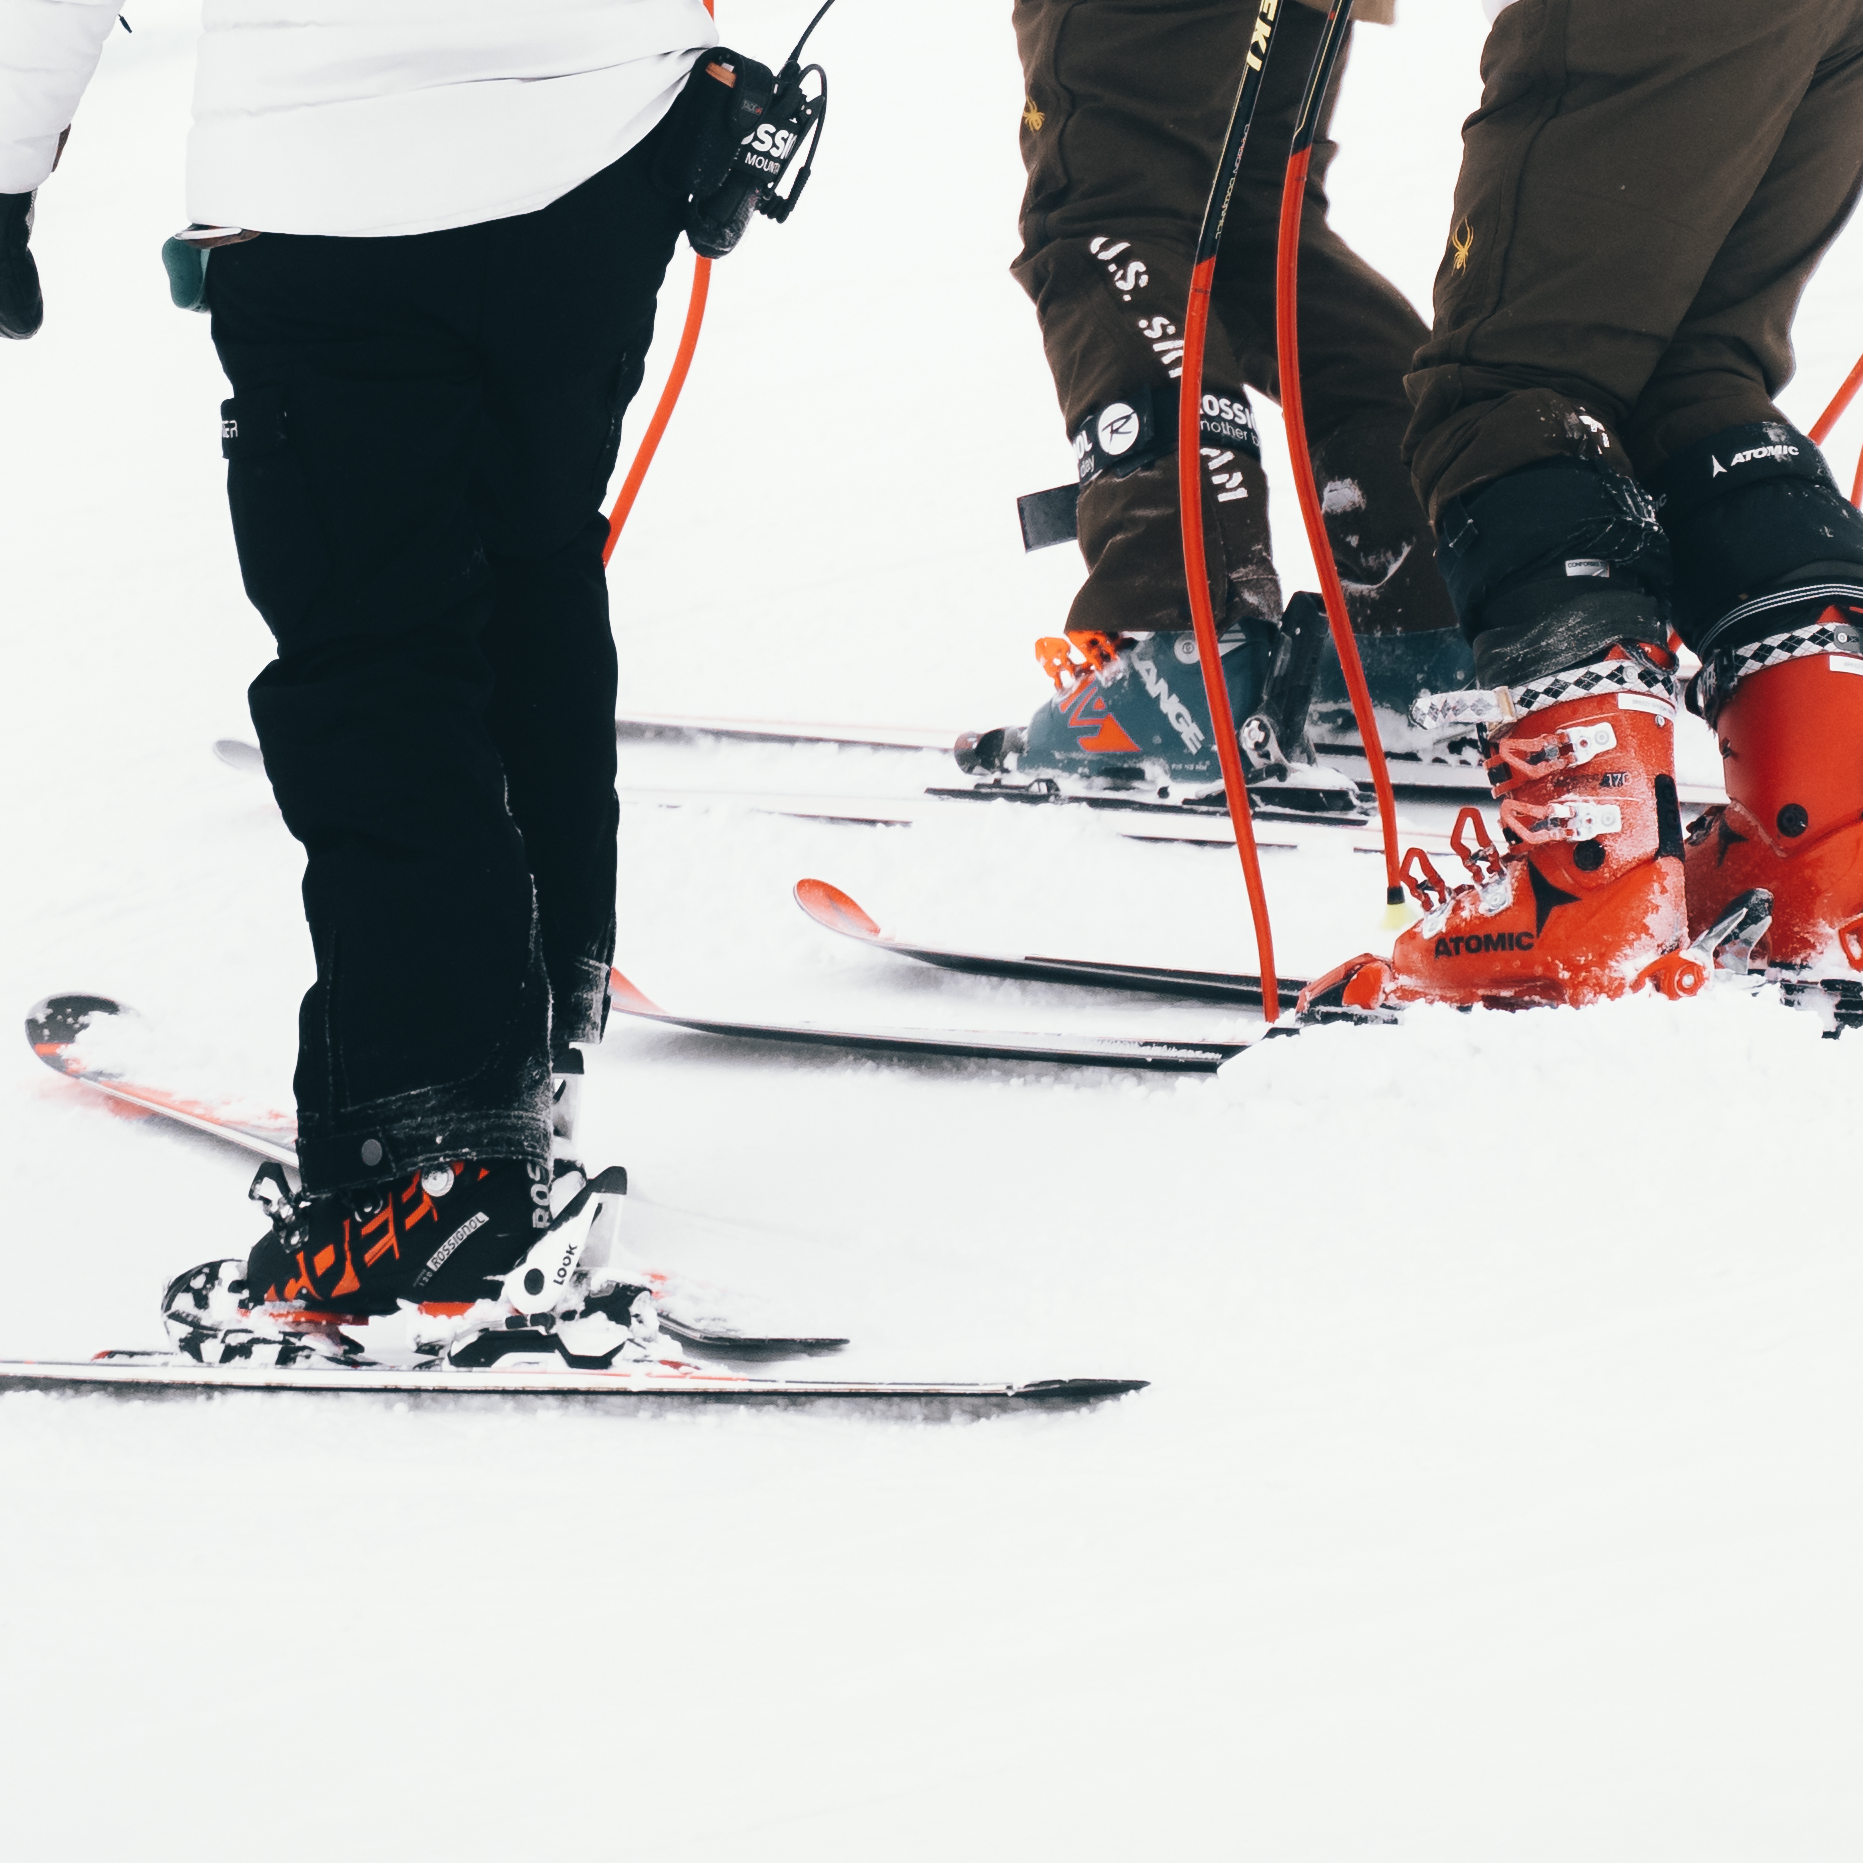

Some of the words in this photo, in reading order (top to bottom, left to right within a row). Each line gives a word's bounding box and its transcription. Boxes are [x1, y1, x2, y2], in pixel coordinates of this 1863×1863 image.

[1090, 236, 1149, 302] U.S.
[1200, 419, 1248, 441] nother
[1730, 444, 1800, 466] ATOMIC
[1434, 931, 1535, 959] ATOMIC
[431, 1215, 486, 1269] ROSSIGNOL
[553, 1243, 578, 1285] LOOK
